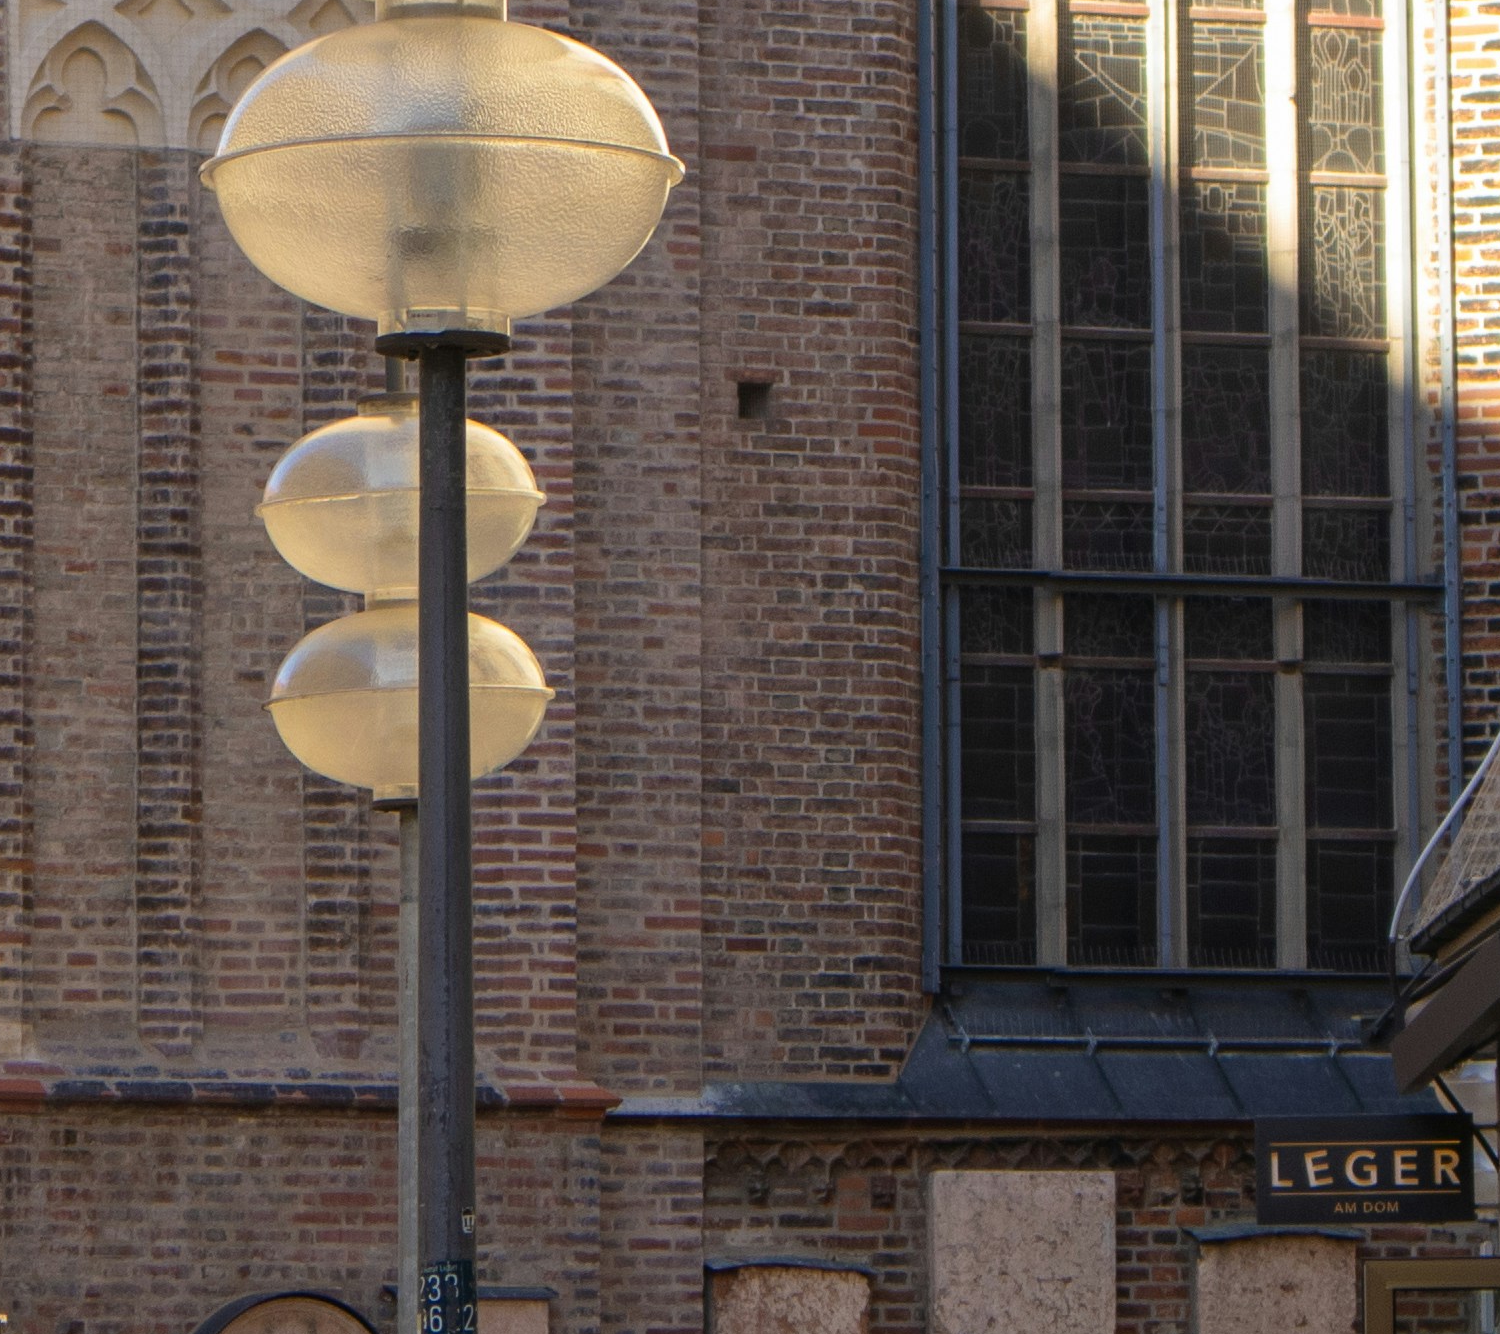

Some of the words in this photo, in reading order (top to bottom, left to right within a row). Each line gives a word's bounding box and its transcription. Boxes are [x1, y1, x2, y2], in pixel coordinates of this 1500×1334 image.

[1269, 1149, 1461, 1189] LEGER
[1333, 1201, 1358, 1214] AM
[1363, 1200, 1399, 1214] DOM
